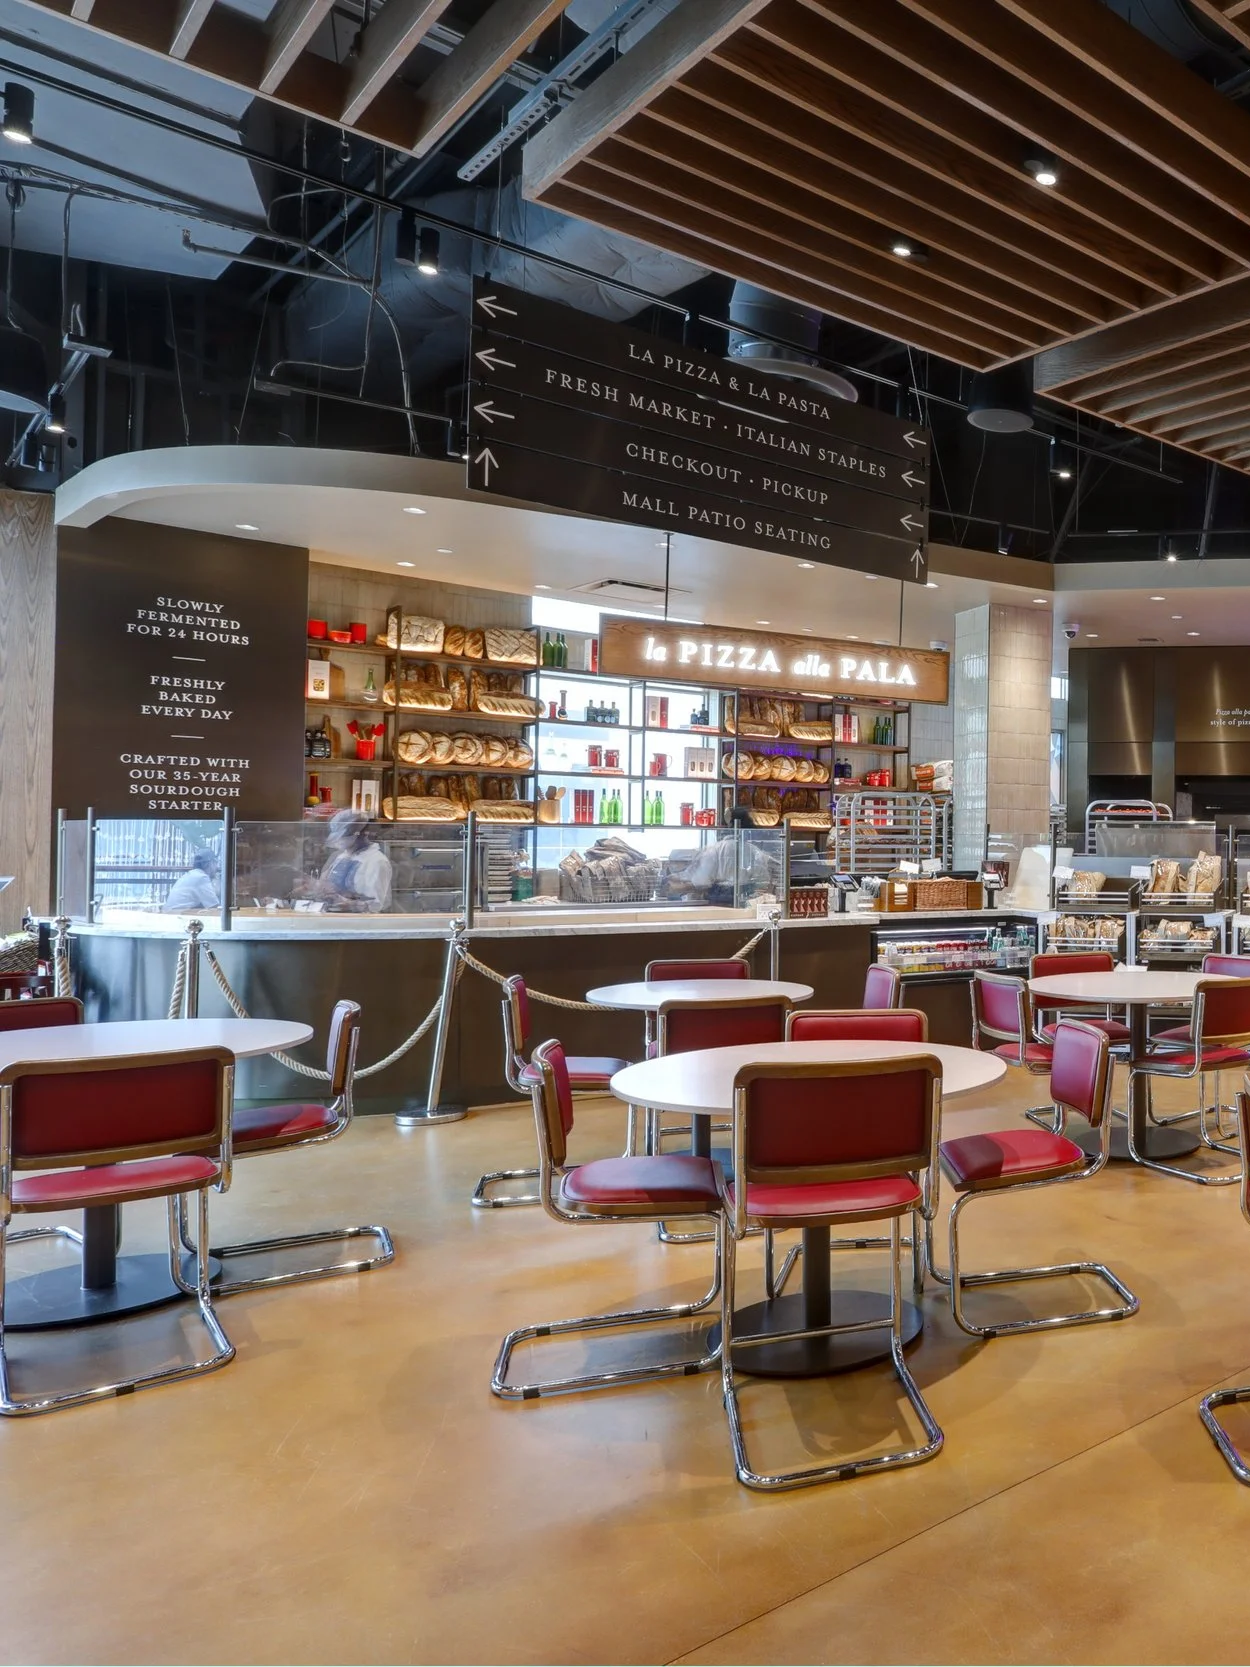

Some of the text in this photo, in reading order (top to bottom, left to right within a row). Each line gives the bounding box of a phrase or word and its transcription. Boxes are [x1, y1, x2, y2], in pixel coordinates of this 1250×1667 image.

[628, 343, 831, 421] LA PIZZA & LA PASTA
[545, 369, 887, 479] FRESH MARKET ITALIAN STAPLES
[626, 443, 829, 505] CHECKOUT PICKUP
[622, 491, 832, 550] MALL PATIO SEATING
[156, 597, 225, 614] SLOWLY
[137, 609, 241, 630] FERMENTED
[126, 623, 250, 646] FOR 24 HOURS
[645, 637, 917, 685] la PIZZA alla PALA
[150, 675, 226, 692] FRESHLY
[158, 691, 217, 705] BAKED
[141, 704, 234, 721] EVERY DAY
[1210, 719, 1226, 727] style
[120, 753, 251, 769] CRAFTED WITH
[129, 769, 242, 783] OUR 35-YEAR
[129, 784, 241, 797] SOURDOUGH
[148, 799, 224, 811] STARTER
